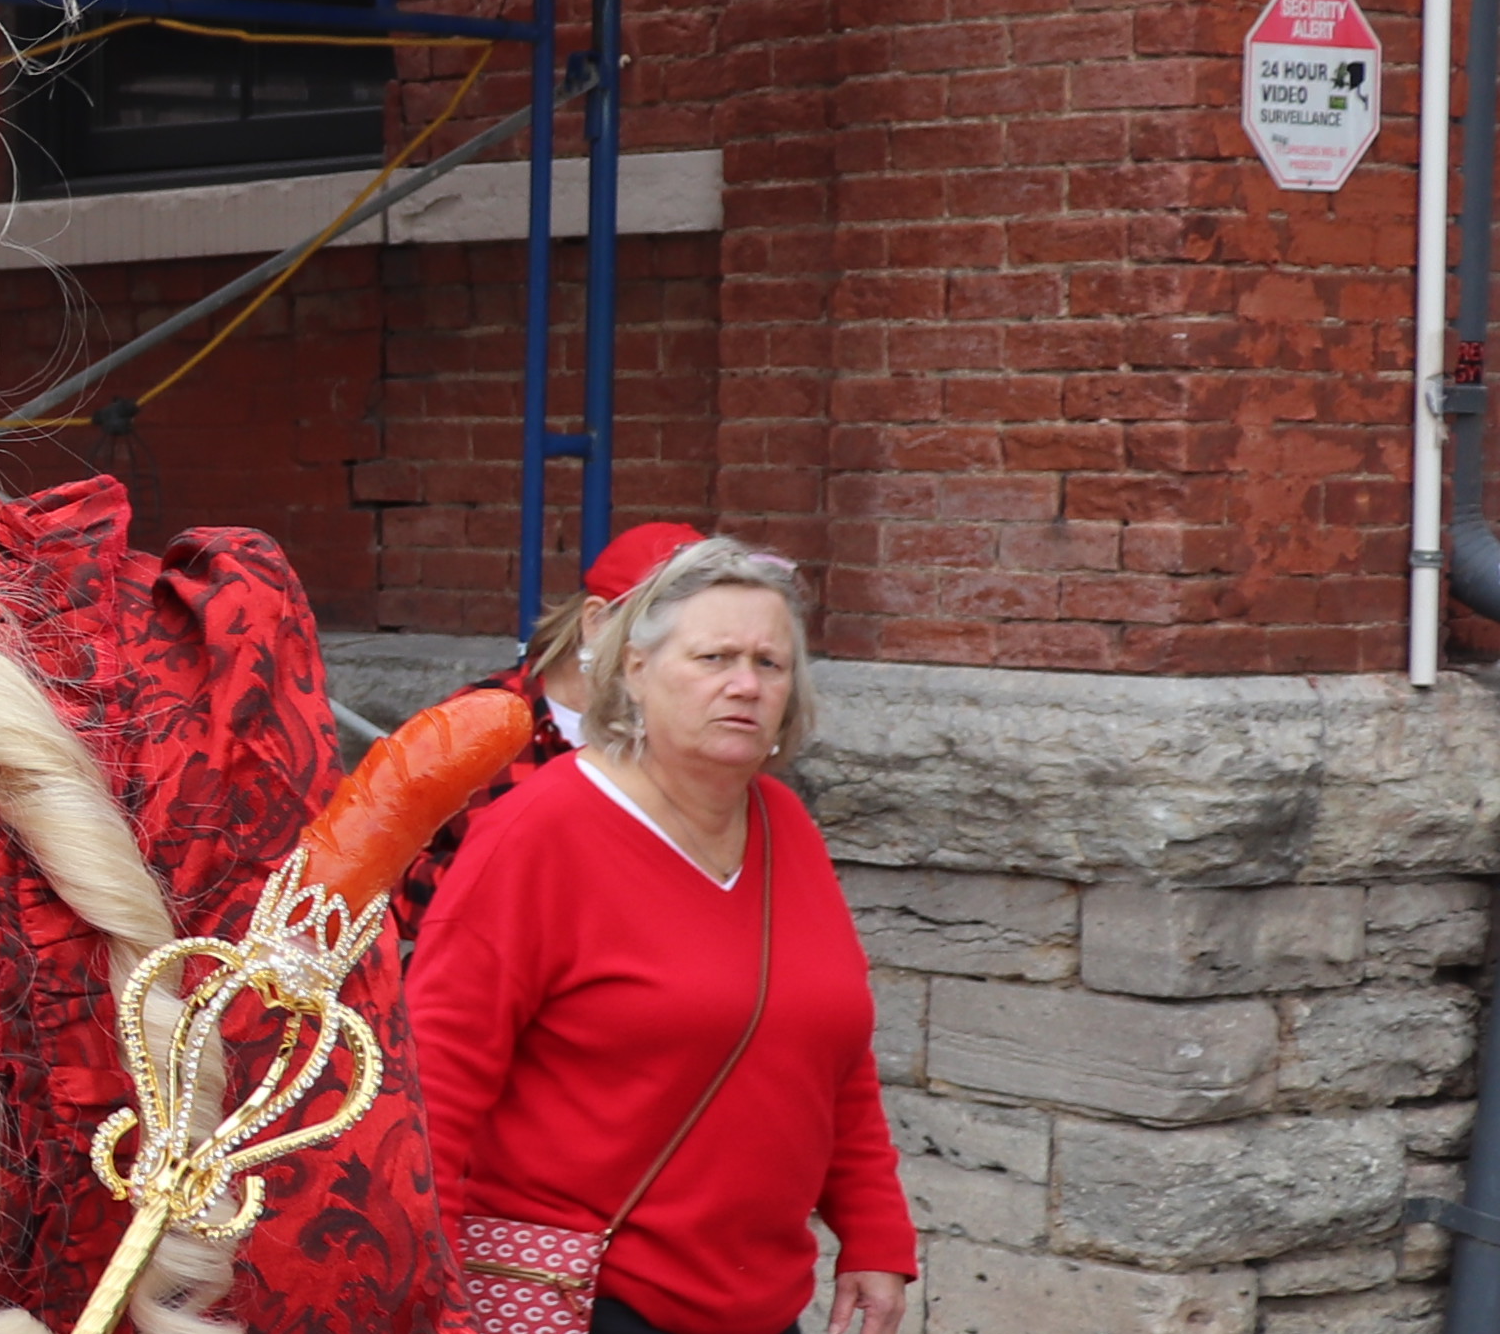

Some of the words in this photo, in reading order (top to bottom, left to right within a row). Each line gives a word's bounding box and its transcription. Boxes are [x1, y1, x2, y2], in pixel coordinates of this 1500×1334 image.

[1290, 19, 1336, 40] ALERT
[1261, 60, 1279, 78] 24
[1283, 62, 1328, 81] HOUR
[1261, 84, 1308, 104] VIDEO
[1260, 108, 1342, 127] SURVEILLANCE
